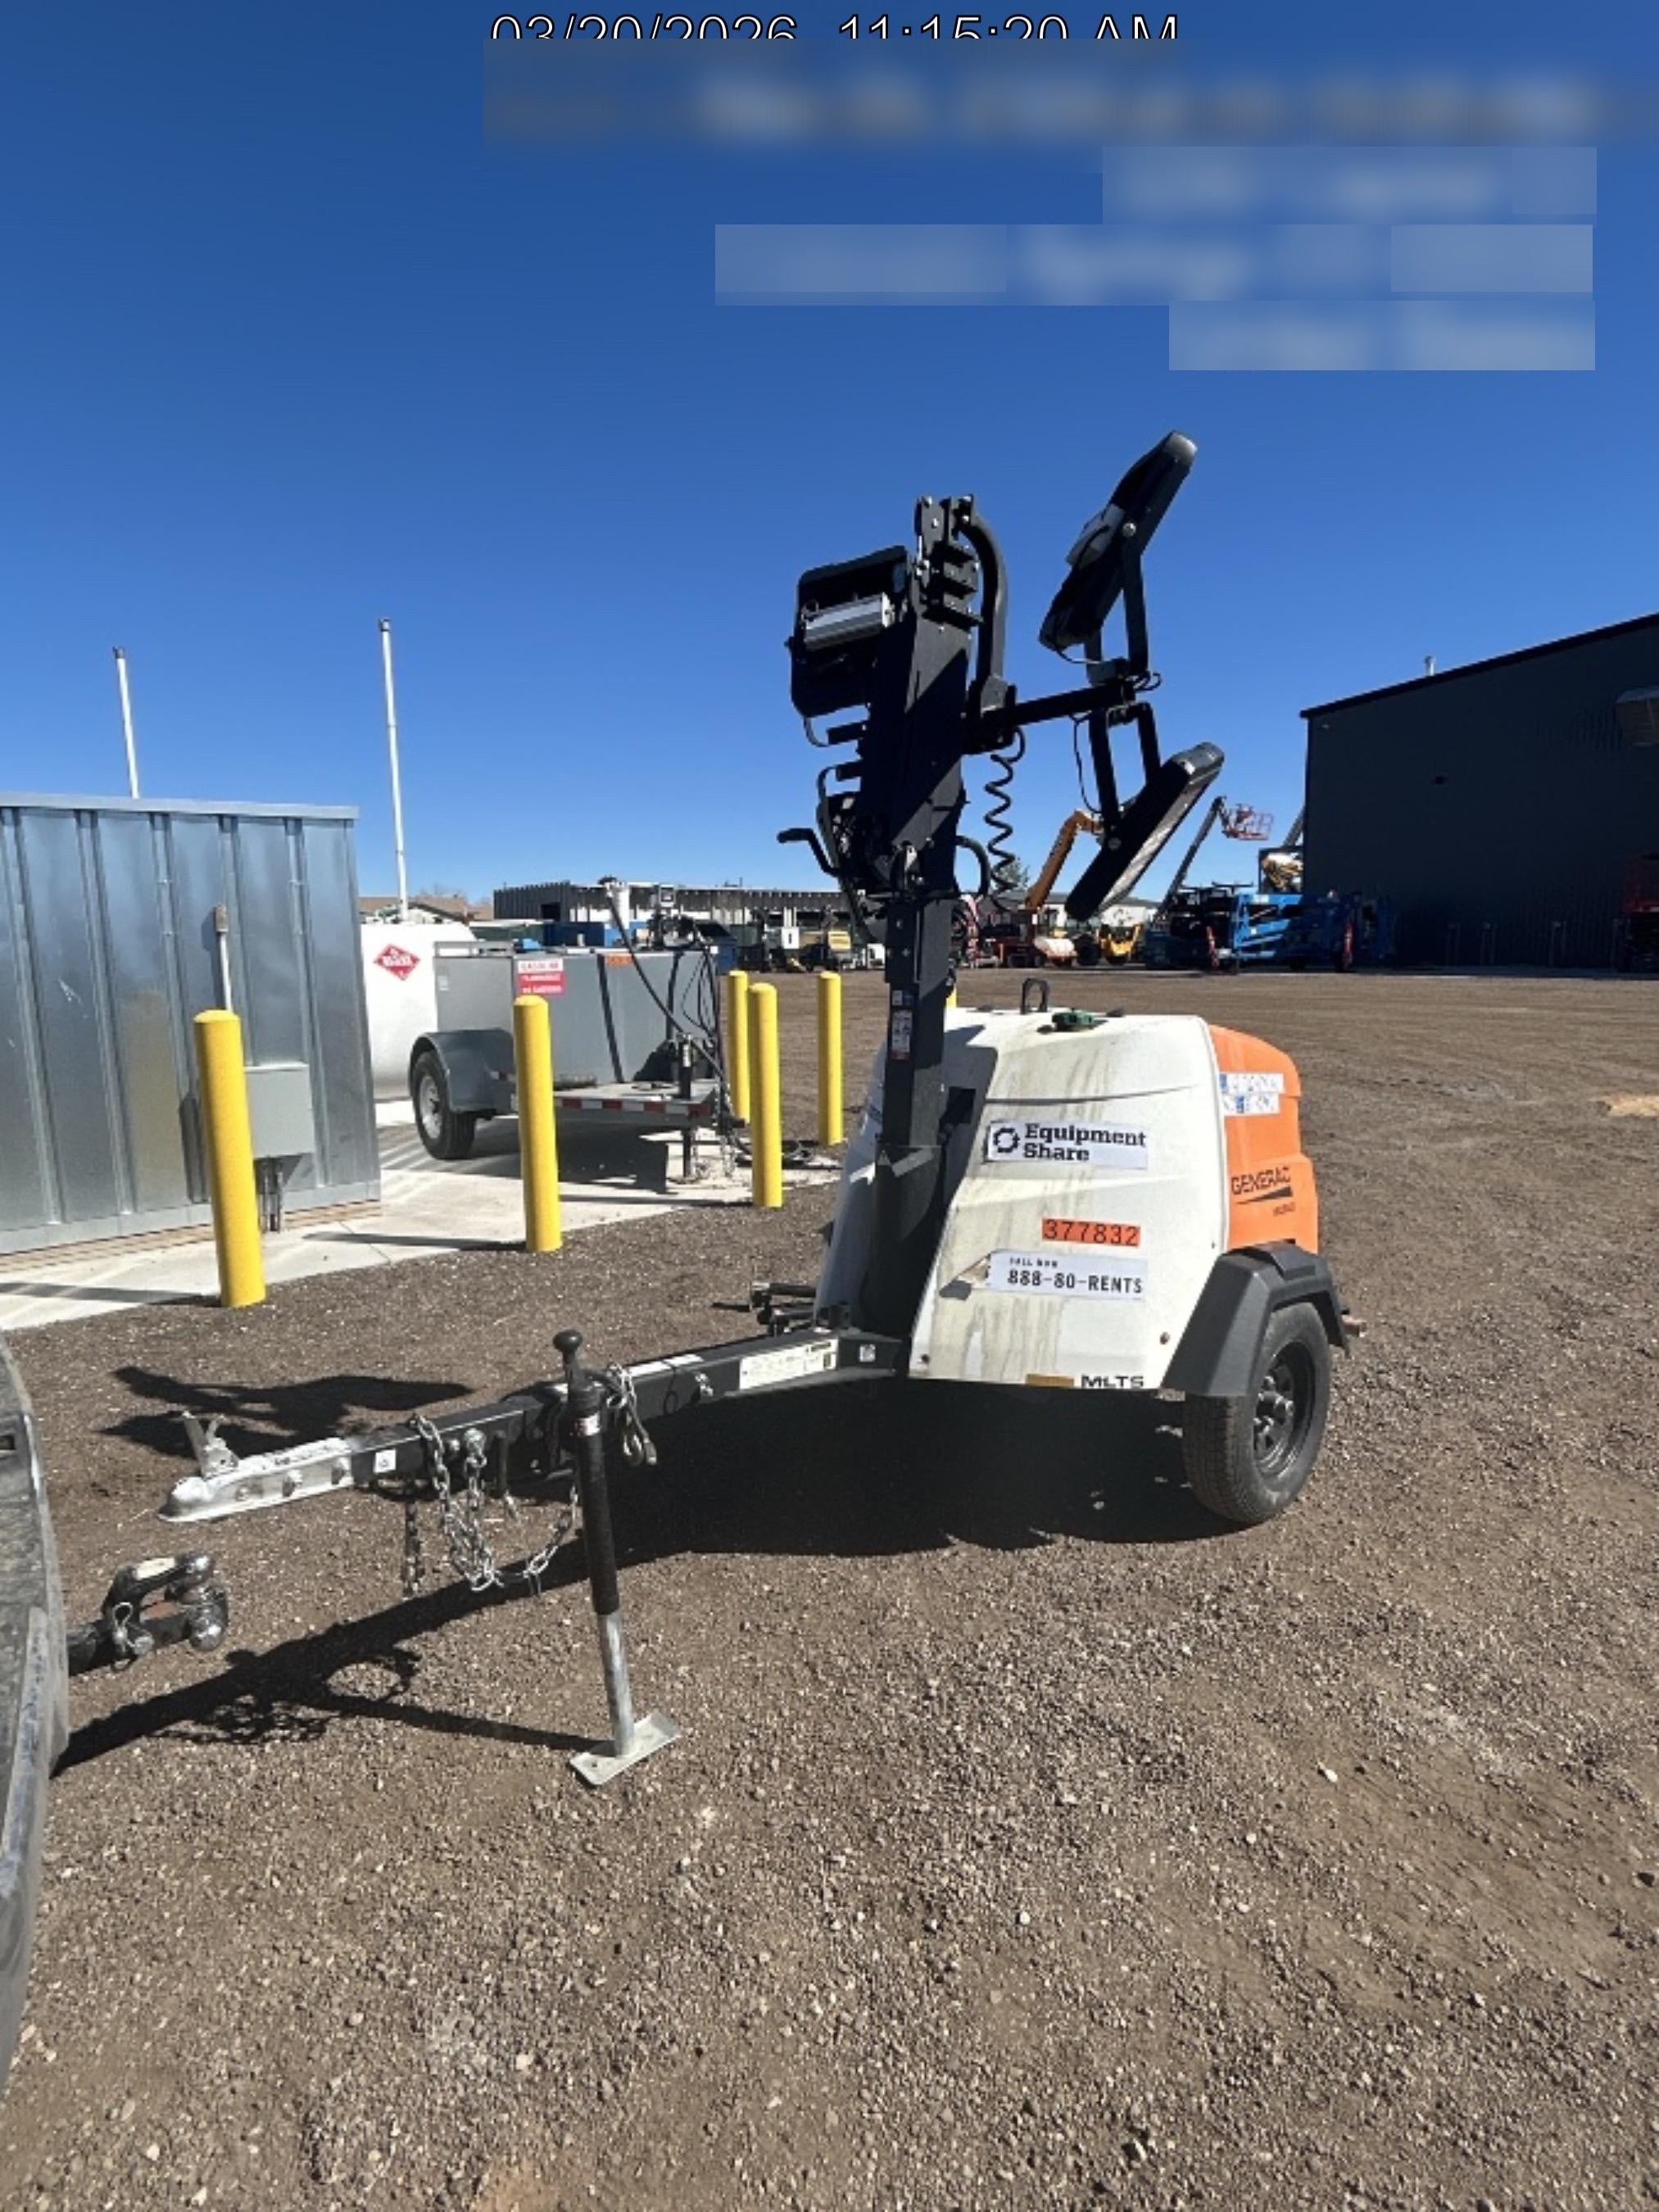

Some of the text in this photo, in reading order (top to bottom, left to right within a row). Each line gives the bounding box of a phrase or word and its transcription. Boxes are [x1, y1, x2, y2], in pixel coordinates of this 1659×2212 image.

[1024, 1123, 1146, 1147] Equipment
[1024, 1142, 1090, 1161] Share
[1044, 1219, 1139, 1246] 377832
[1008, 1269, 1142, 1294] 888-80-RENTS
